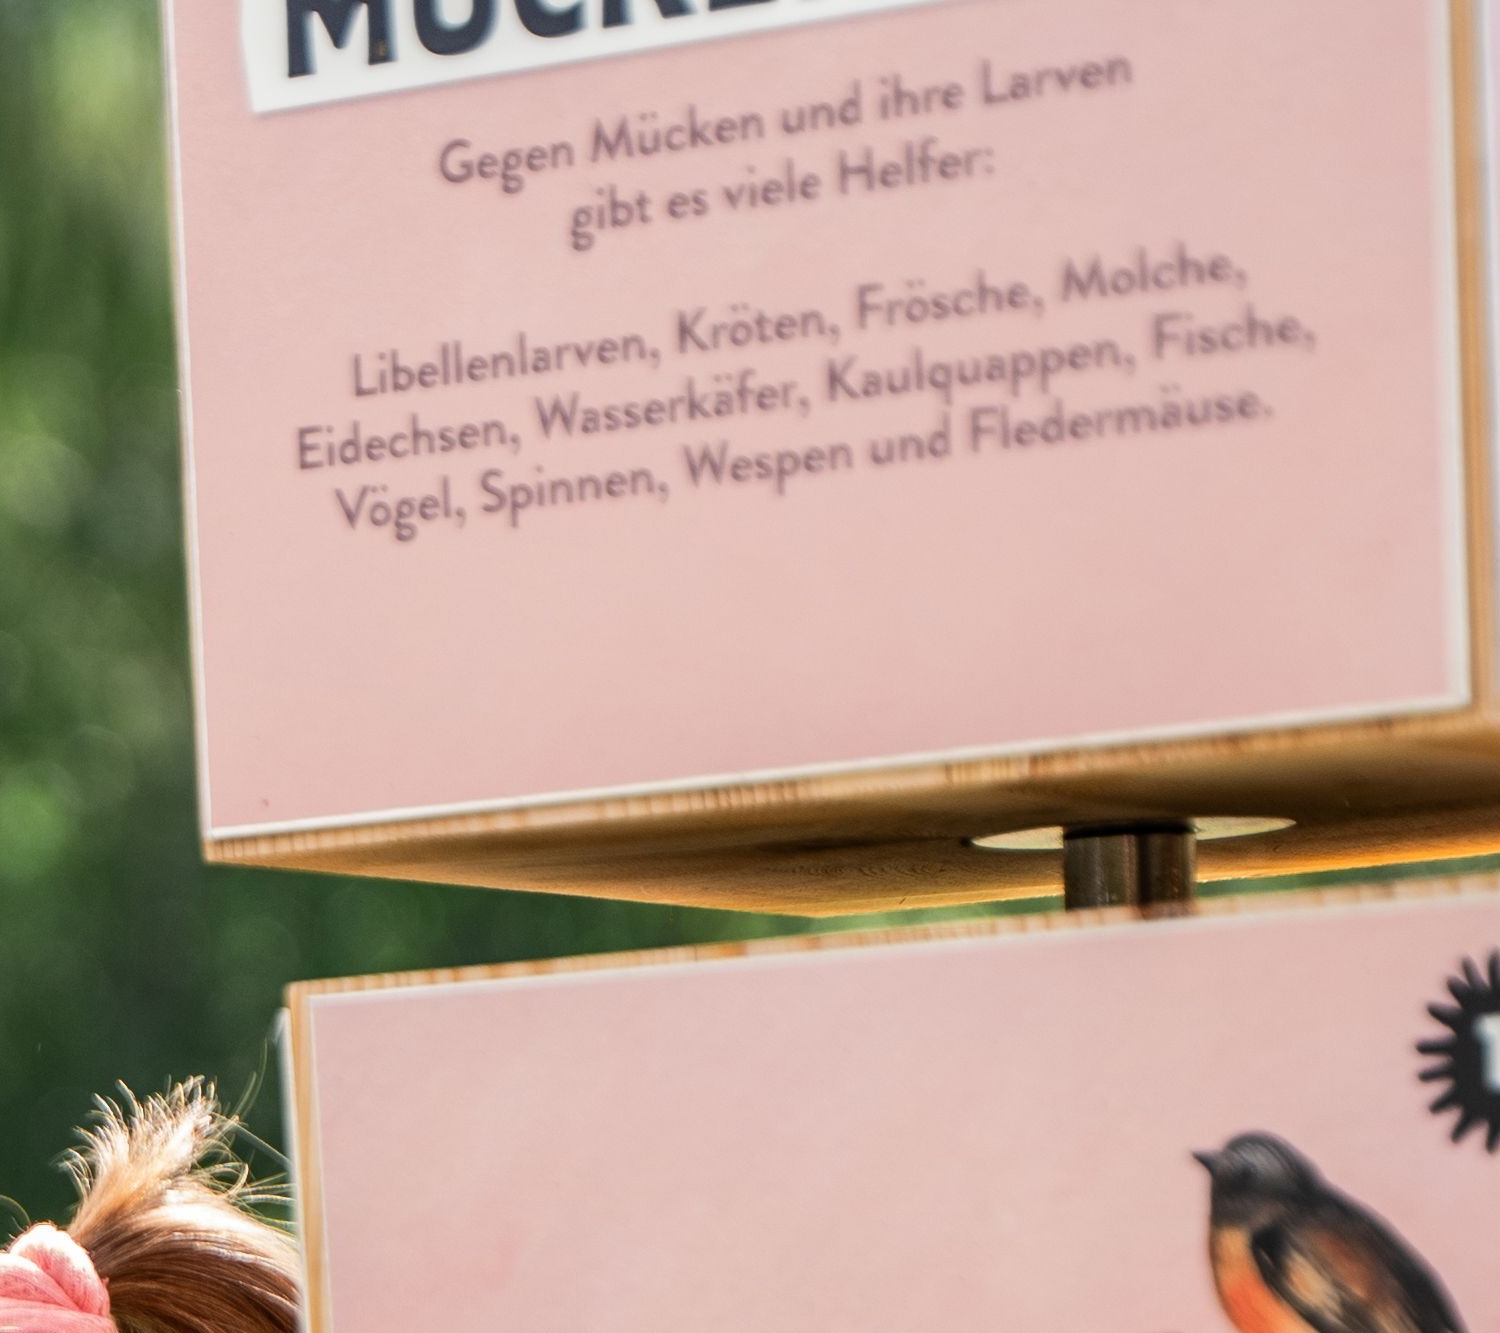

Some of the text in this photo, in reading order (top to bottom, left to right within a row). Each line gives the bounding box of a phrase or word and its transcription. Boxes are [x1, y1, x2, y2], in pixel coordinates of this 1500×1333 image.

[440, 55, 1133, 194] Gegen Mücken und ihre Larven
[570, 139, 995, 251] gibt es viele Helfer:
[297, 306, 1317, 470] Eidechsen, Wasserkäfer, Kaulquappen, Fische,
[353, 240, 1247, 398] Libellenlarven, Kröten, Frösche, Molche,
[334, 386, 1273, 542] Vögel, Spinnen, Wespen und Fledermäuse.
